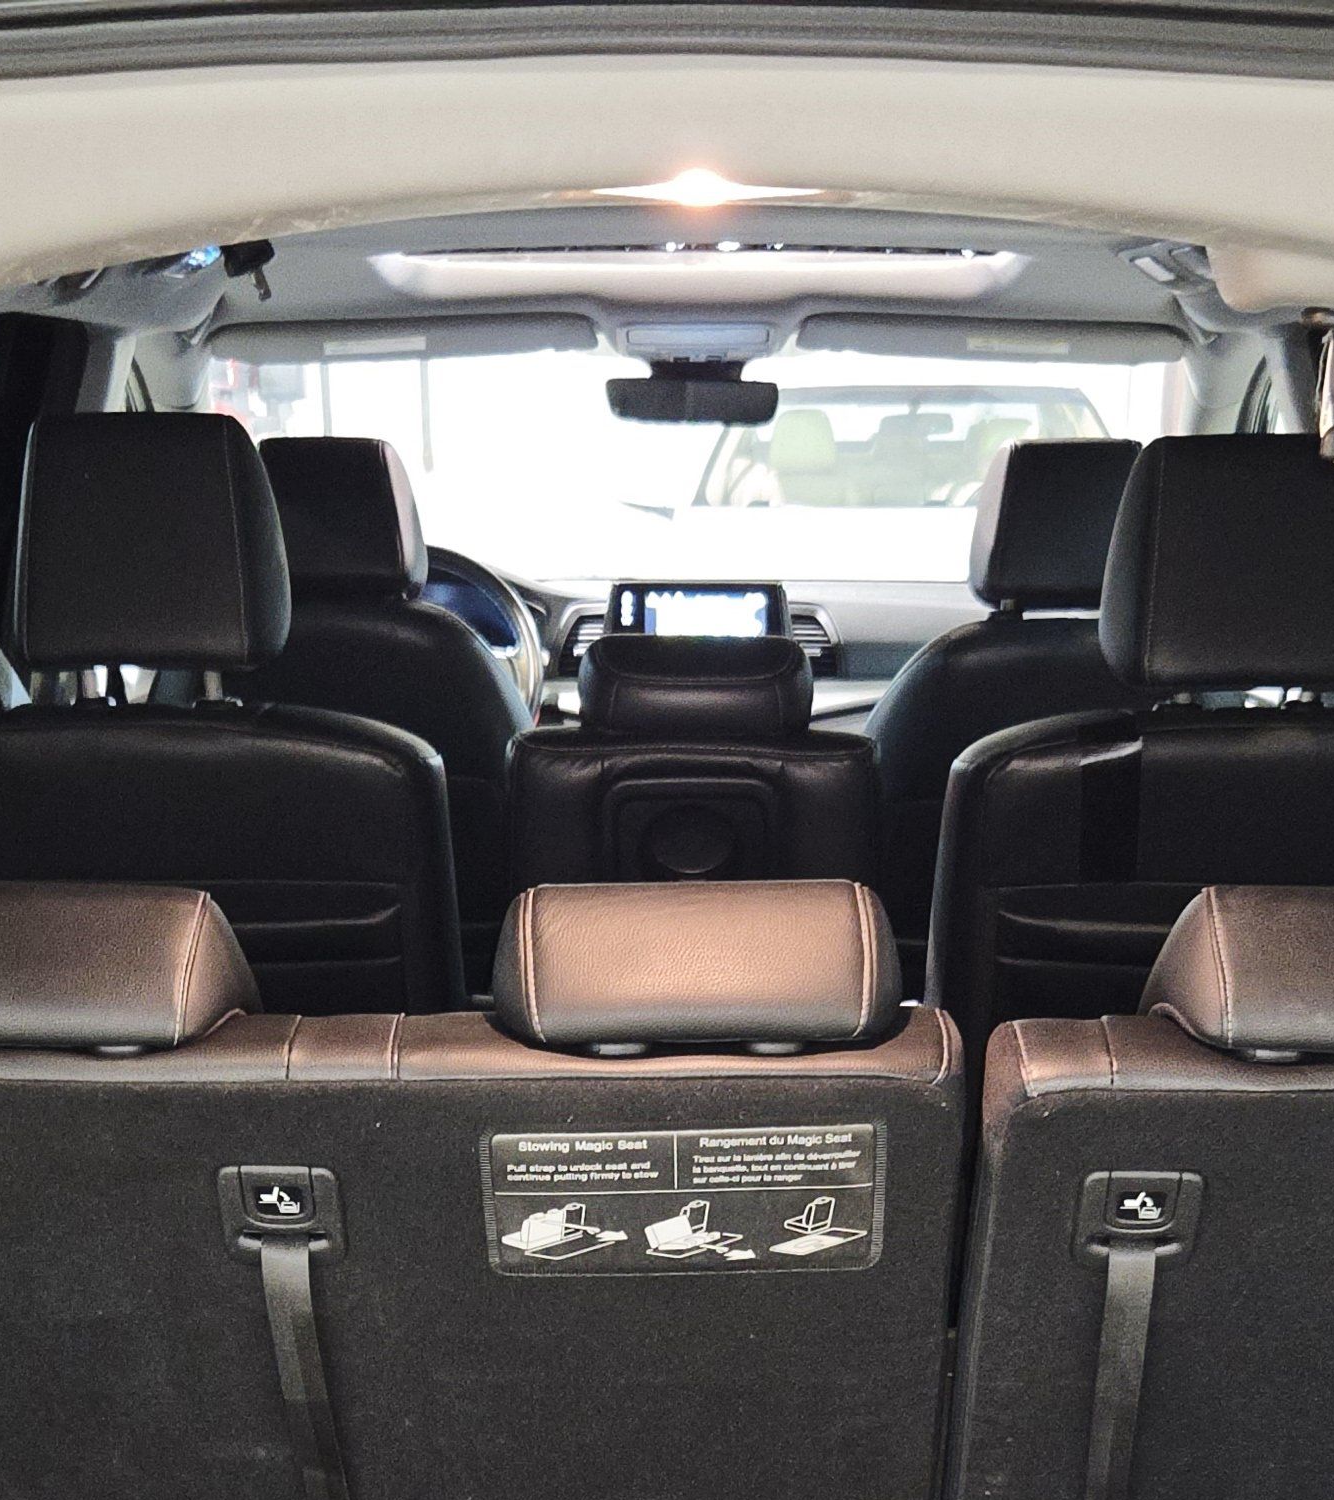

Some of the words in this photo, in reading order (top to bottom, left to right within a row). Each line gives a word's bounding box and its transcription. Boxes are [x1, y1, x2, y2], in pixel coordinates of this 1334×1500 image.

[700, 1136, 766, 1148] Rangement
[769, 1135, 784, 1145] du
[787, 1134, 822, 1146] Magic
[825, 1133, 852, 1143] Seat
[519, 1142, 569, 1153] Stowing
[575, 1141, 613, 1152] Magic
[618, 1140, 647, 1150] Seat
[693, 1155, 715, 1163] Tirez
[507, 1164, 526, 1172] Pull
[529, 1164, 555, 1173] strap
[570, 1163, 602, 1171] unlock
[554, 1173, 587, 1182] pulling
[590, 1172, 620, 1181] firmly
